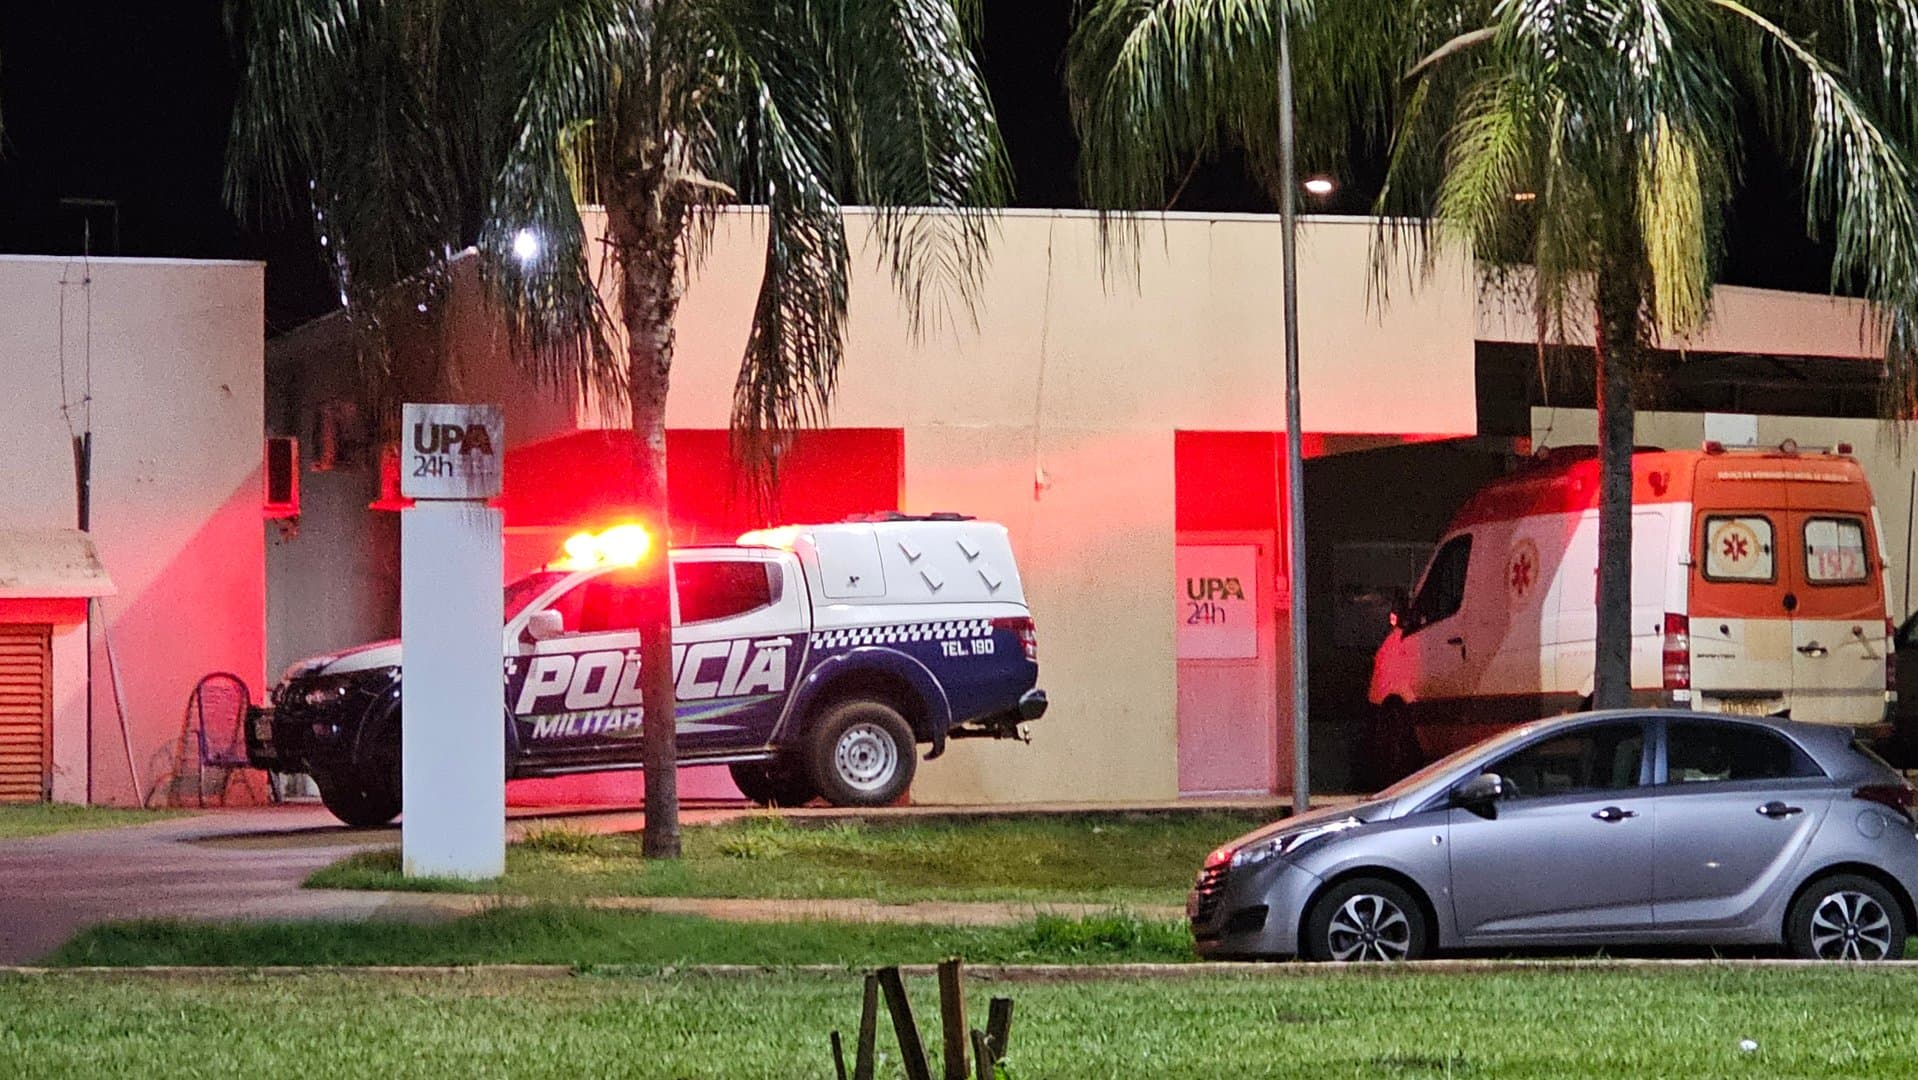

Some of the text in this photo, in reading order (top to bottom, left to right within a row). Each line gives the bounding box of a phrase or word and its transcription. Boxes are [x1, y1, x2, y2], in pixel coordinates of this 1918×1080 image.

[414, 423, 494, 455] UPA
[413, 455, 453, 477] 24h
[1186, 577, 1245, 601] UPA
[1186, 602, 1226, 624] 24h
[940, 638, 994, 657] TEL. 190
[515, 638, 788, 715] POLCIA
[532, 706, 644, 739] MILITAR
